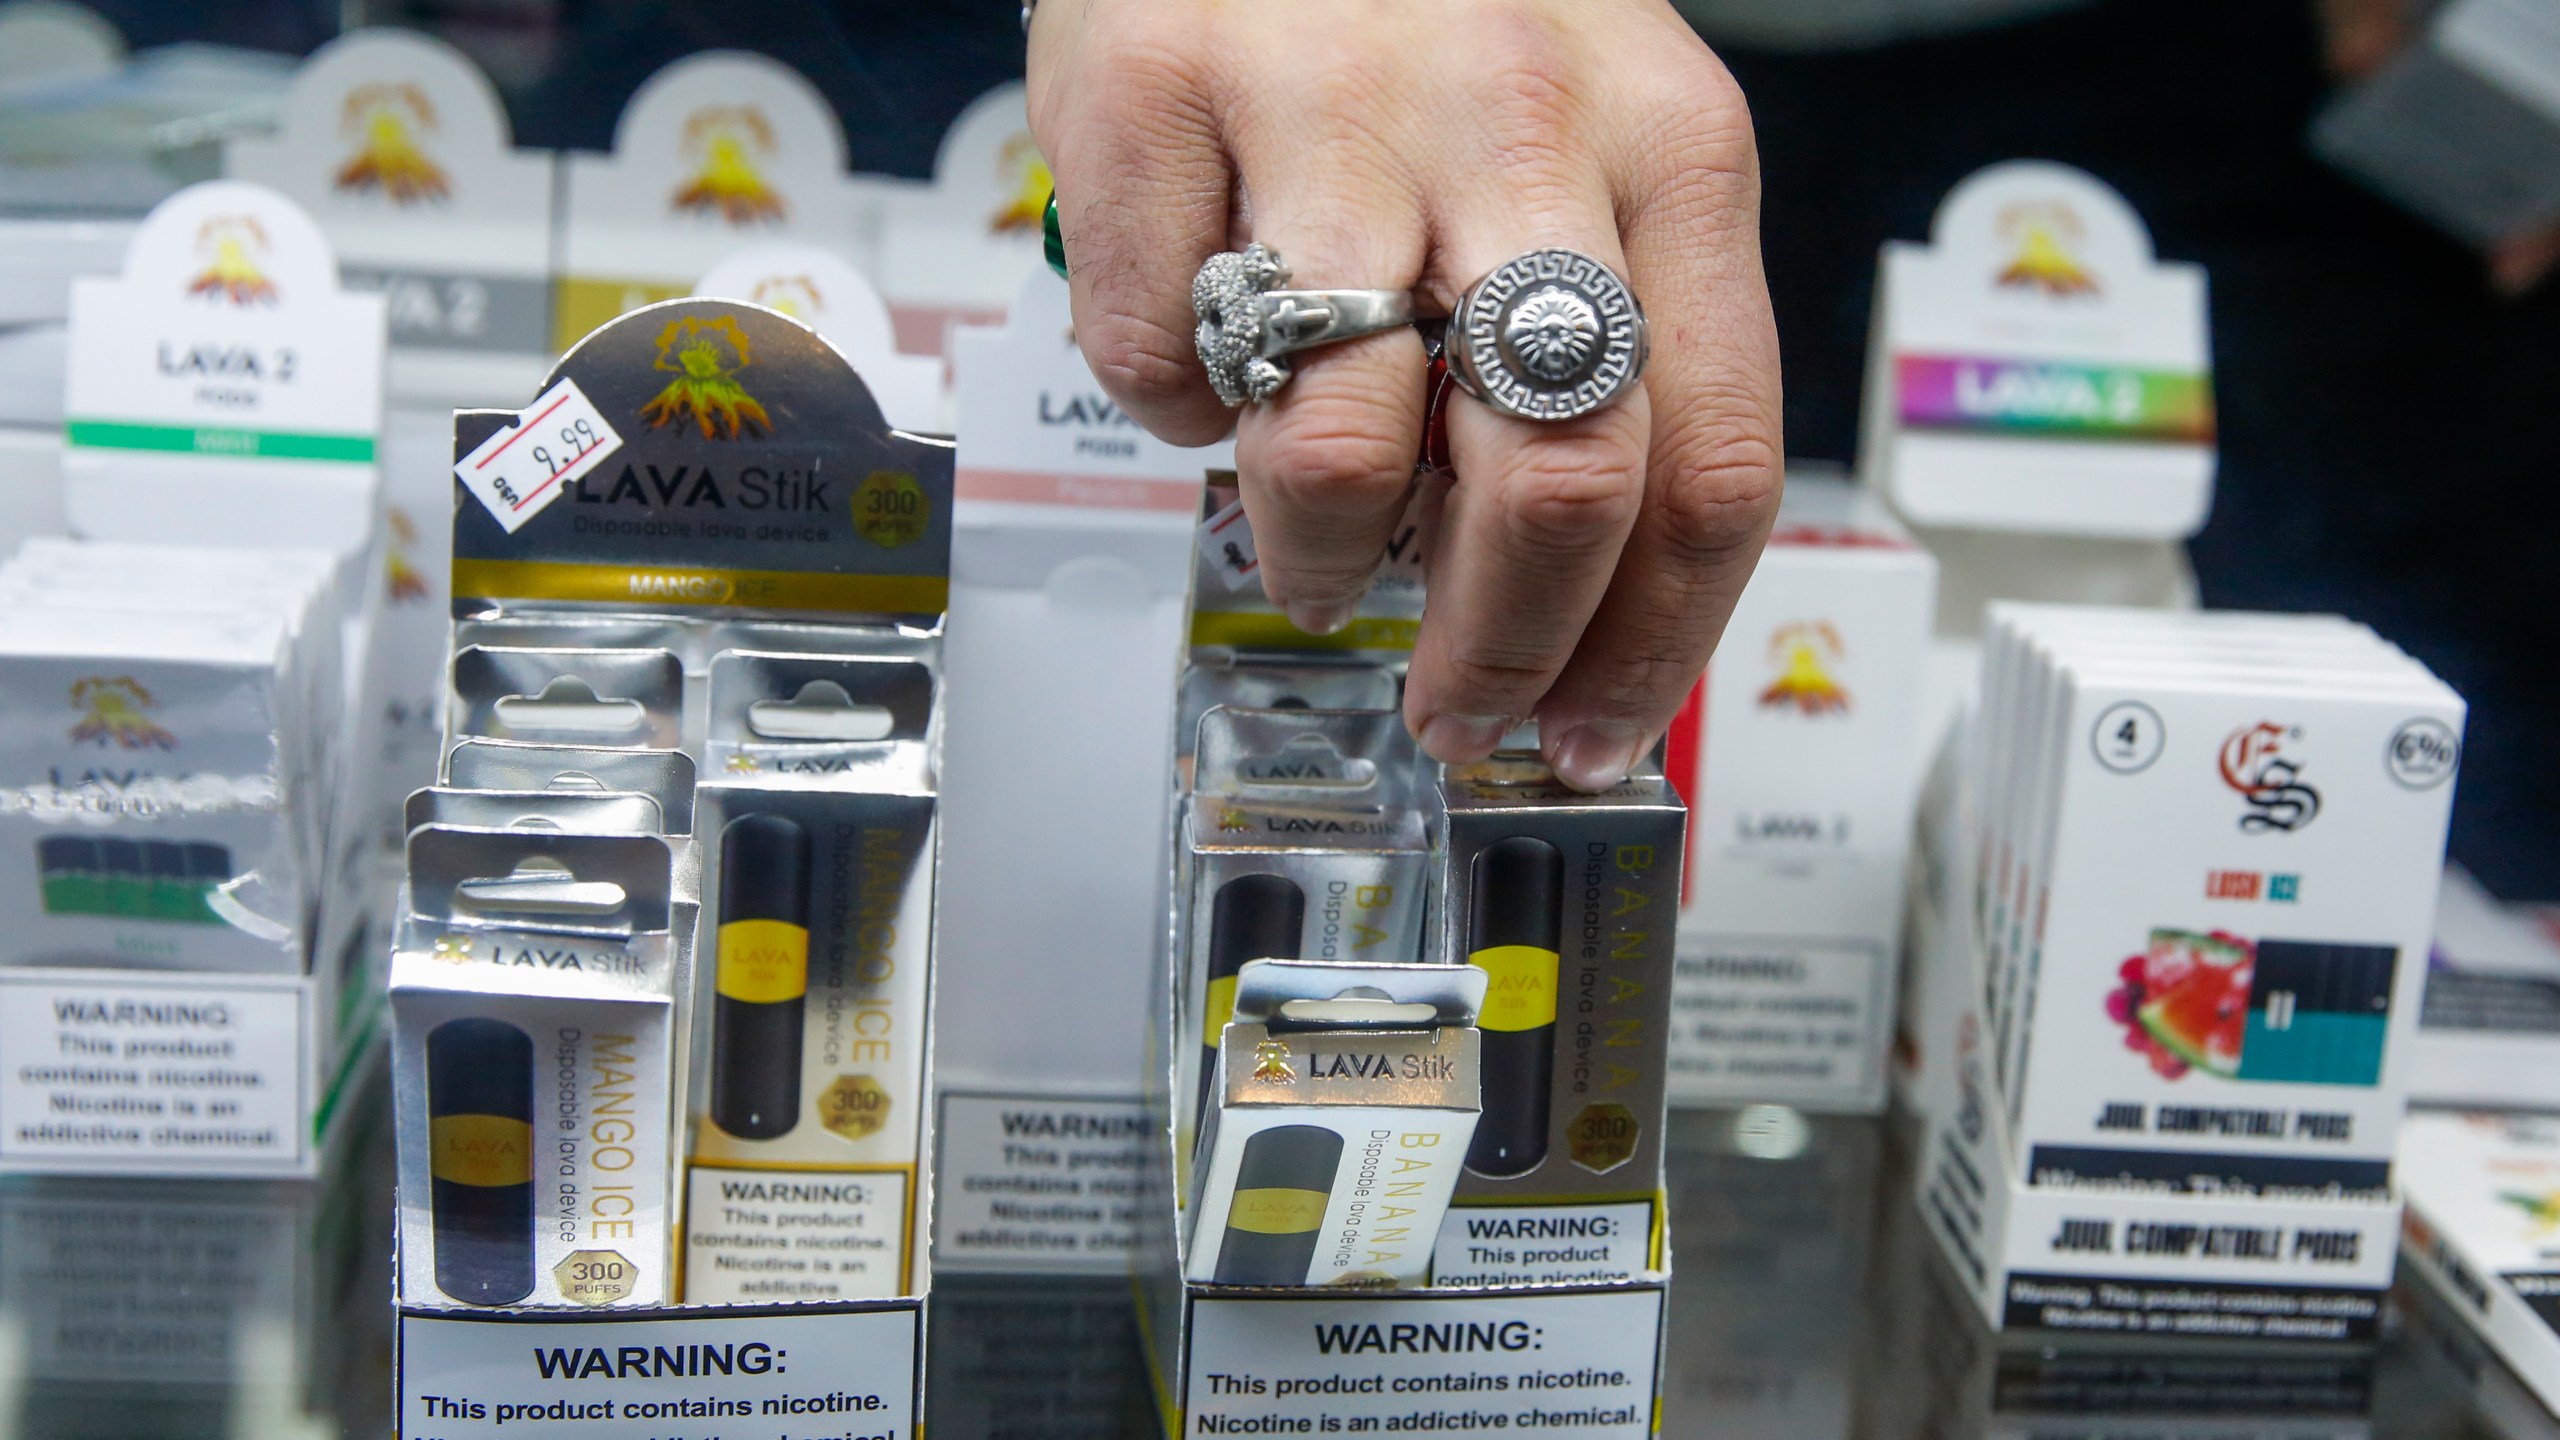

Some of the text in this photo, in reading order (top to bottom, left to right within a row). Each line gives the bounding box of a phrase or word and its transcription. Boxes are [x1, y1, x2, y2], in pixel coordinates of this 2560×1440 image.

[156, 340, 264, 380] LAVA
[532, 418, 598, 476] 9.99
[574, 464, 830, 513] LAVA Stik
[866, 488, 917, 514] 300
[573, 515, 830, 542] Disposable lava device
[629, 574, 726, 598] MANGO
[2116, 718, 2137, 745] 4
[2395, 733, 2450, 762] 6%
[777, 759, 853, 774] LAVA
[1251, 763, 1325, 779] LAVA
[1267, 817, 1343, 834] LAVA
[1322, 880, 1348, 961] Disposa
[733, 946, 792, 965] LAVA
[852, 829, 902, 1062] MANGO ICE
[492, 946, 646, 975] LAVA Stik
[1573, 842, 1607, 1094] Disposable lava device
[1601, 844, 1655, 1091] BANANA
[1488, 974, 1543, 991] AVA
[1310, 1053, 1455, 1080] LAVA Stik
[832, 1091, 880, 1111] 300
[559, 1027, 581, 1243] Disposable lava device
[591, 1033, 637, 1240] MANGO ICE
[1582, 1117, 1627, 1140] 300
[721, 1181, 873, 1204] WARNING:
[1333, 1129, 1391, 1267] Disposable lava device
[1362, 1132, 1441, 1266] BANANA
[722, 1209, 864, 1230] This product
[1467, 1217, 1619, 1239] WARNING:
[692, 1234, 888, 1251] contains nicotine.
[715, 1255, 867, 1273] Nicotine is an
[1468, 1247, 1610, 1267] This product
[571, 1261, 623, 1281] 300
[1437, 1271, 1534, 1287] contains
[574, 1284, 621, 1295] PUFFS
[1316, 1320, 1544, 1355] WARNING:
[535, 1342, 788, 1379] WARNING:
[1207, 1367, 1632, 1401] This product contains nicotine.
[421, 1391, 889, 1425] This product contains nicotine.
[1197, 1404, 1643, 1437] Nicotine is an addictive chemical.
